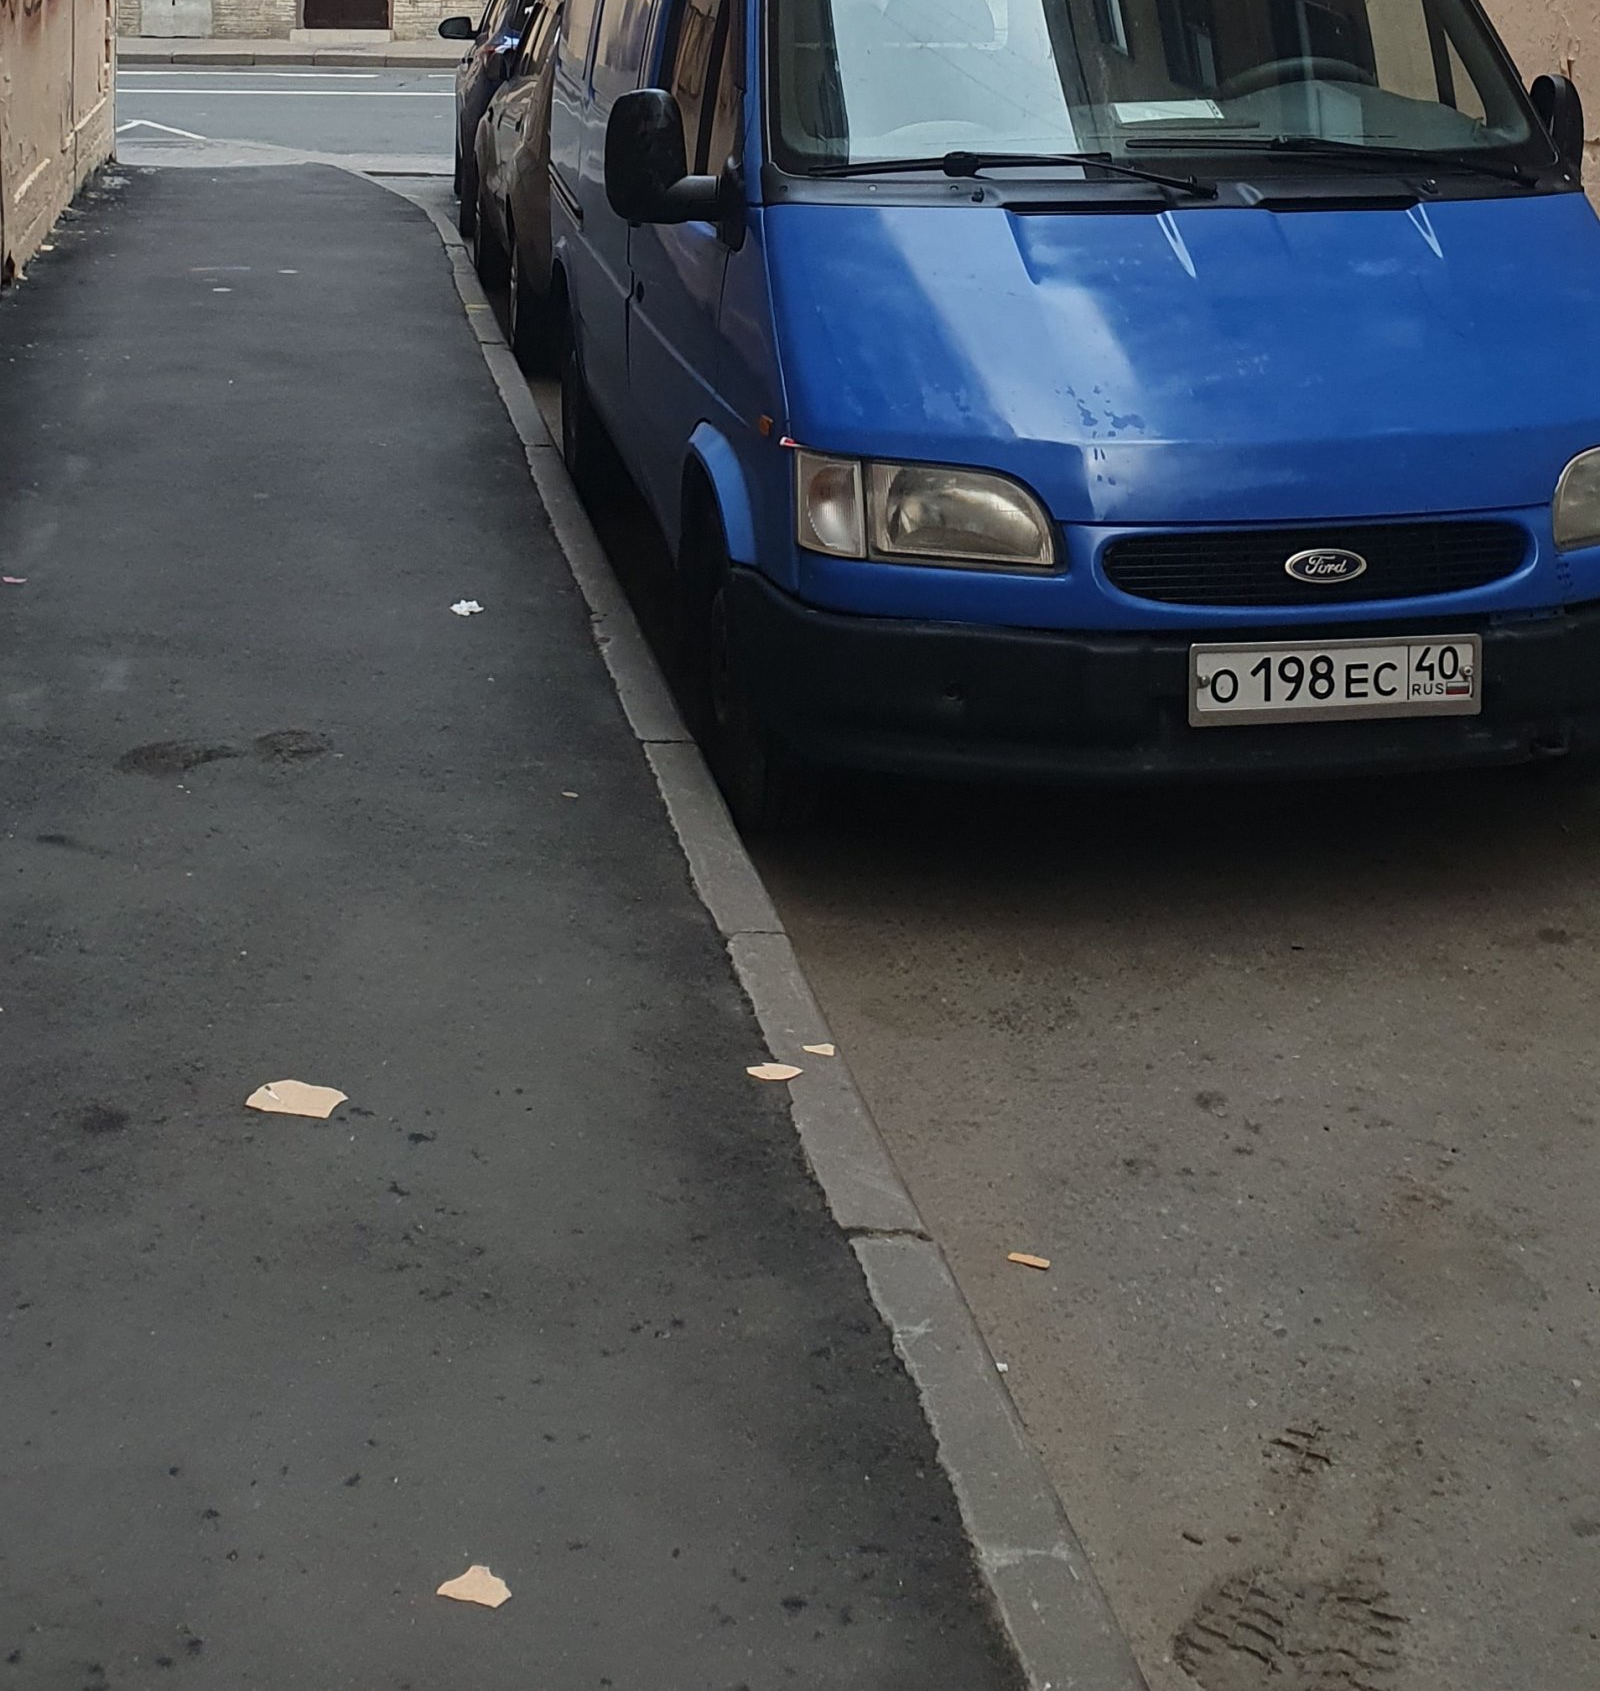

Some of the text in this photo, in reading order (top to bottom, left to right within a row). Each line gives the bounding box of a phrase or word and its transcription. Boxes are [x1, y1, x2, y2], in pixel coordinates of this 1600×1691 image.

[1305, 555, 1347, 575] Ford
[1415, 646, 1459, 681] 40
[1250, 655, 1335, 702] 198
[1411, 682, 1444, 696] RUS
